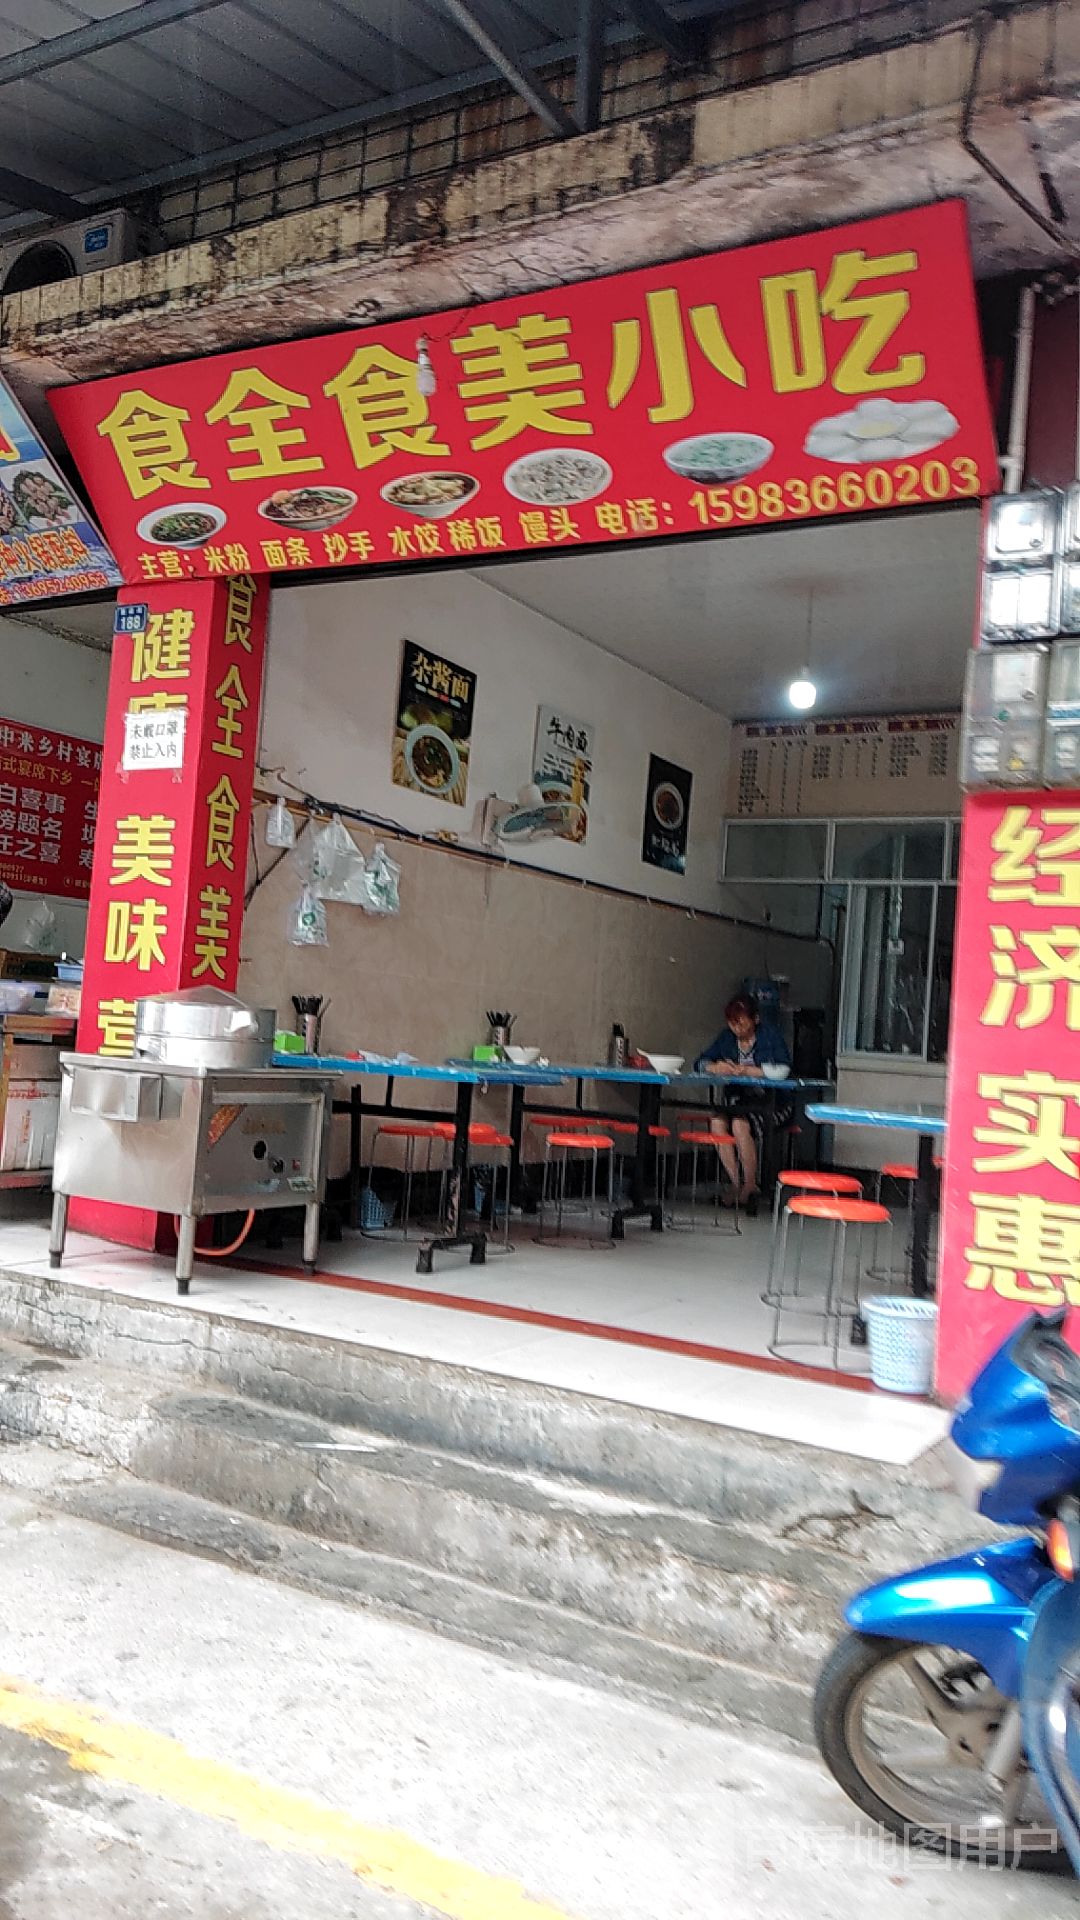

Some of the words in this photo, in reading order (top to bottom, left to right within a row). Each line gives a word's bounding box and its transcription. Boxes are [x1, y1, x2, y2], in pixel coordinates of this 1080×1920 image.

[97, 249, 927, 500] 食全食美小吃
[203, 543, 250, 573] 米粉
[260, 537, 312, 568] 面条
[388, 521, 445, 556] 水饺
[447, 516, 506, 551] 稀饭
[519, 507, 581, 543] 馒头
[688, 456, 981, 525] 15983660203
[967, 805, 1080, 1307] 经济实惠
